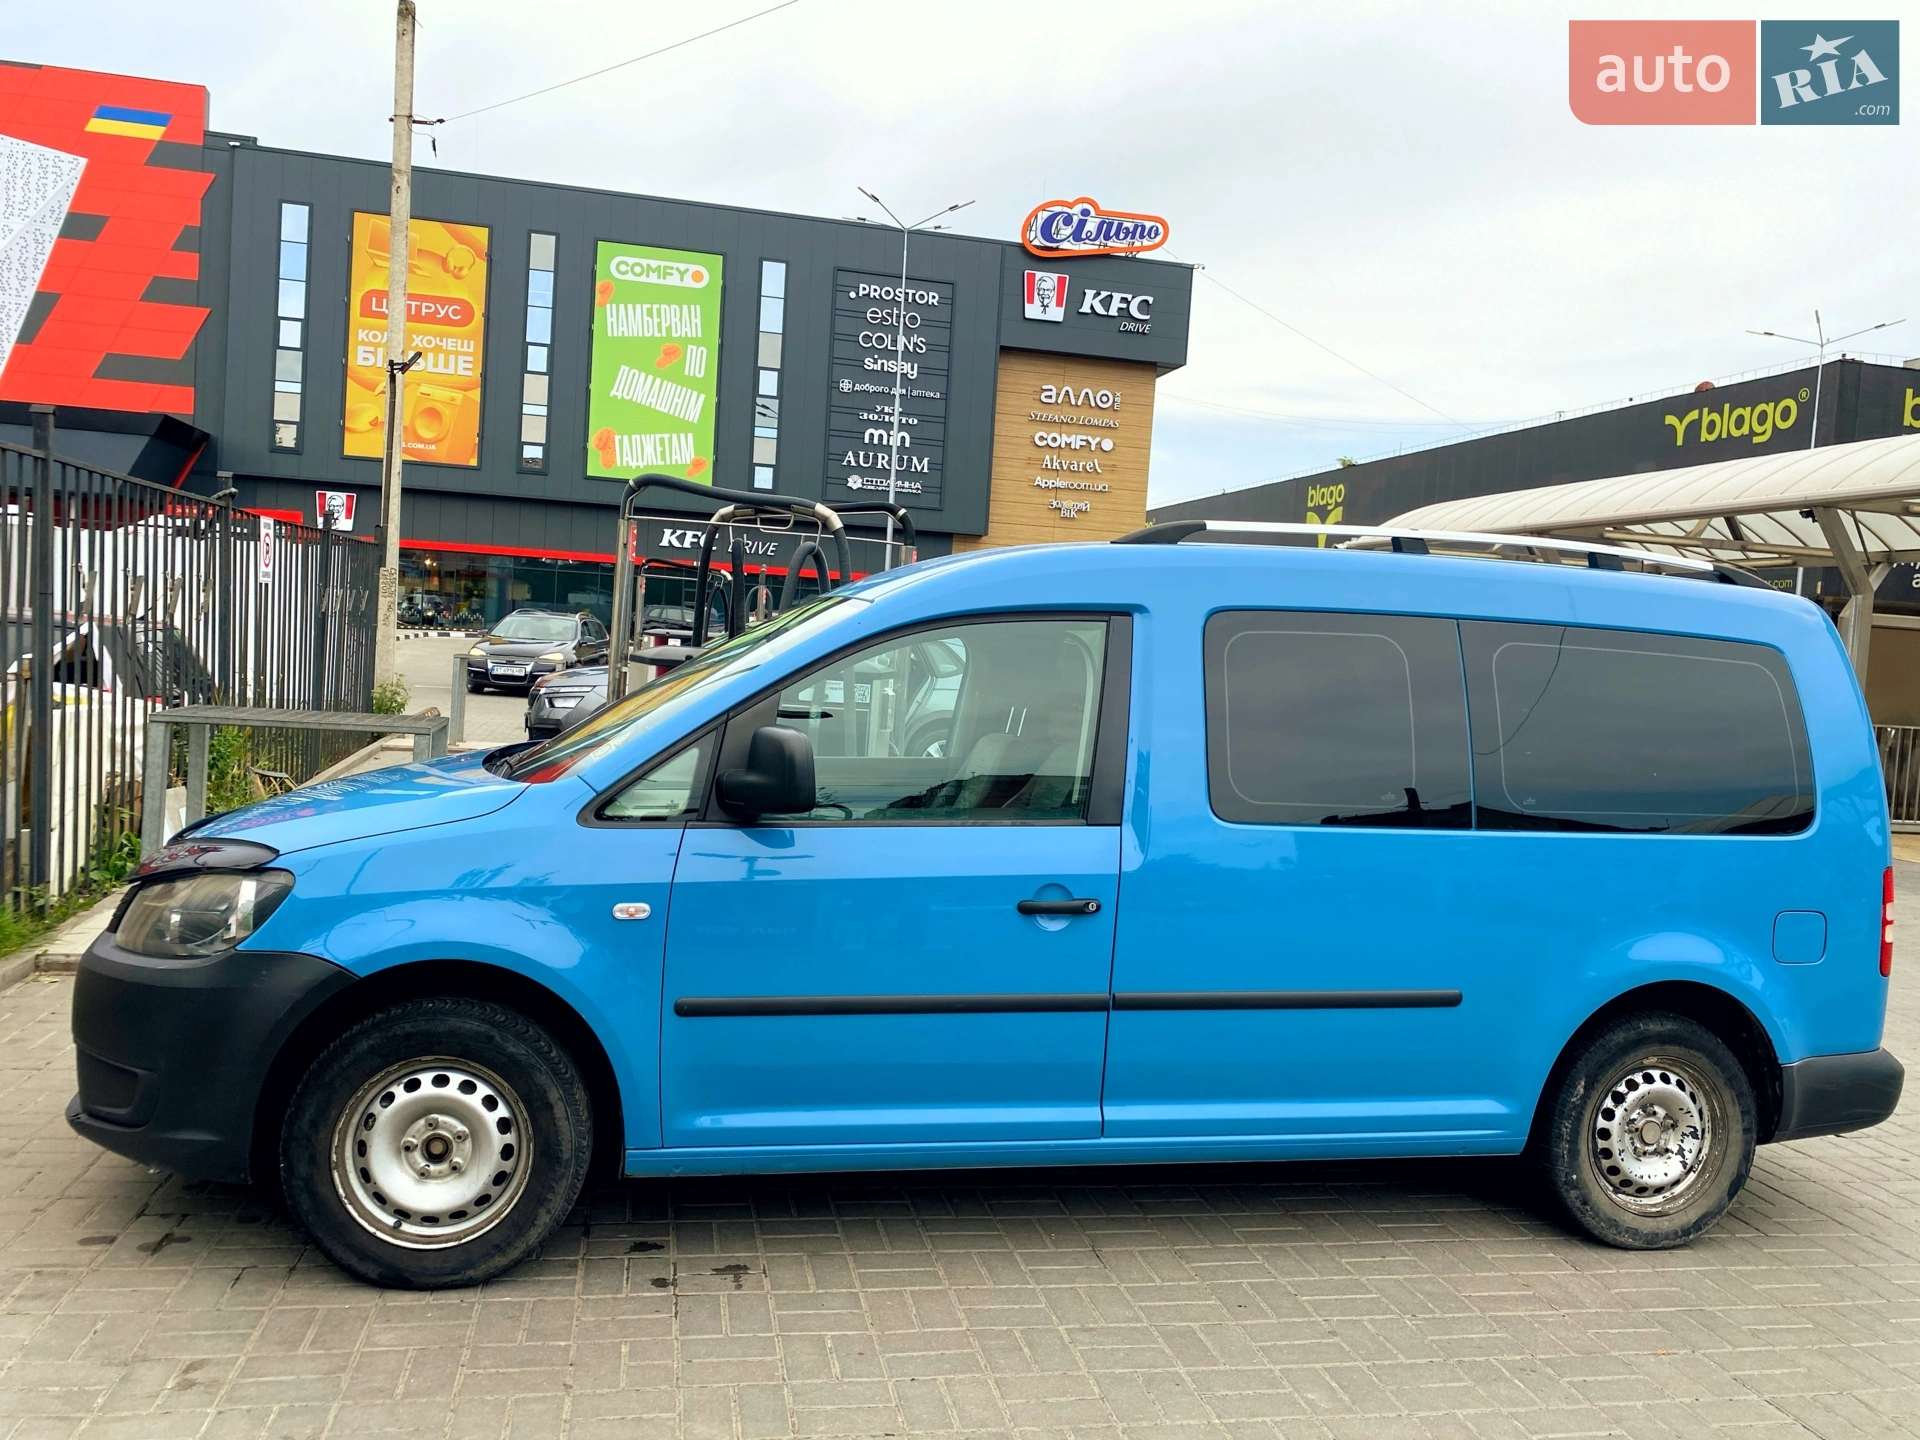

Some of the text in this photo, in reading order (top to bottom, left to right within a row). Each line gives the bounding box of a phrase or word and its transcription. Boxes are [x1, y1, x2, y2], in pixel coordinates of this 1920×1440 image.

[1039, 207, 1162, 244] Сільпо
[615, 260, 689, 282] COMFY
[371, 296, 462, 320] ЦТРУС
[1078, 289, 1154, 320] KFC
[606, 303, 702, 338] НАМБЕРВАН
[1119, 321, 1152, 333] DRIVE
[411, 334, 475, 353] ХОЧЕШ
[356, 345, 474, 377] БІЬШЕ
[684, 344, 708, 379] ПО
[863, 355, 918, 379] sinsay
[610, 365, 705, 424] ДОМАШНІМ
[854, 383, 889, 394] доброго
[911, 388, 940, 399] аптека
[1028, 411, 1077, 424] STEFANO
[864, 428, 910, 448] min
[1034, 431, 1101, 451] COMFY
[614, 433, 695, 469] ГАДЖЕТАМ
[841, 450, 930, 473] AURUM
[1042, 455, 1102, 473] Akvarel
[1034, 476, 1108, 492] Appleroom.ua
[1307, 483, 1345, 510] blago
